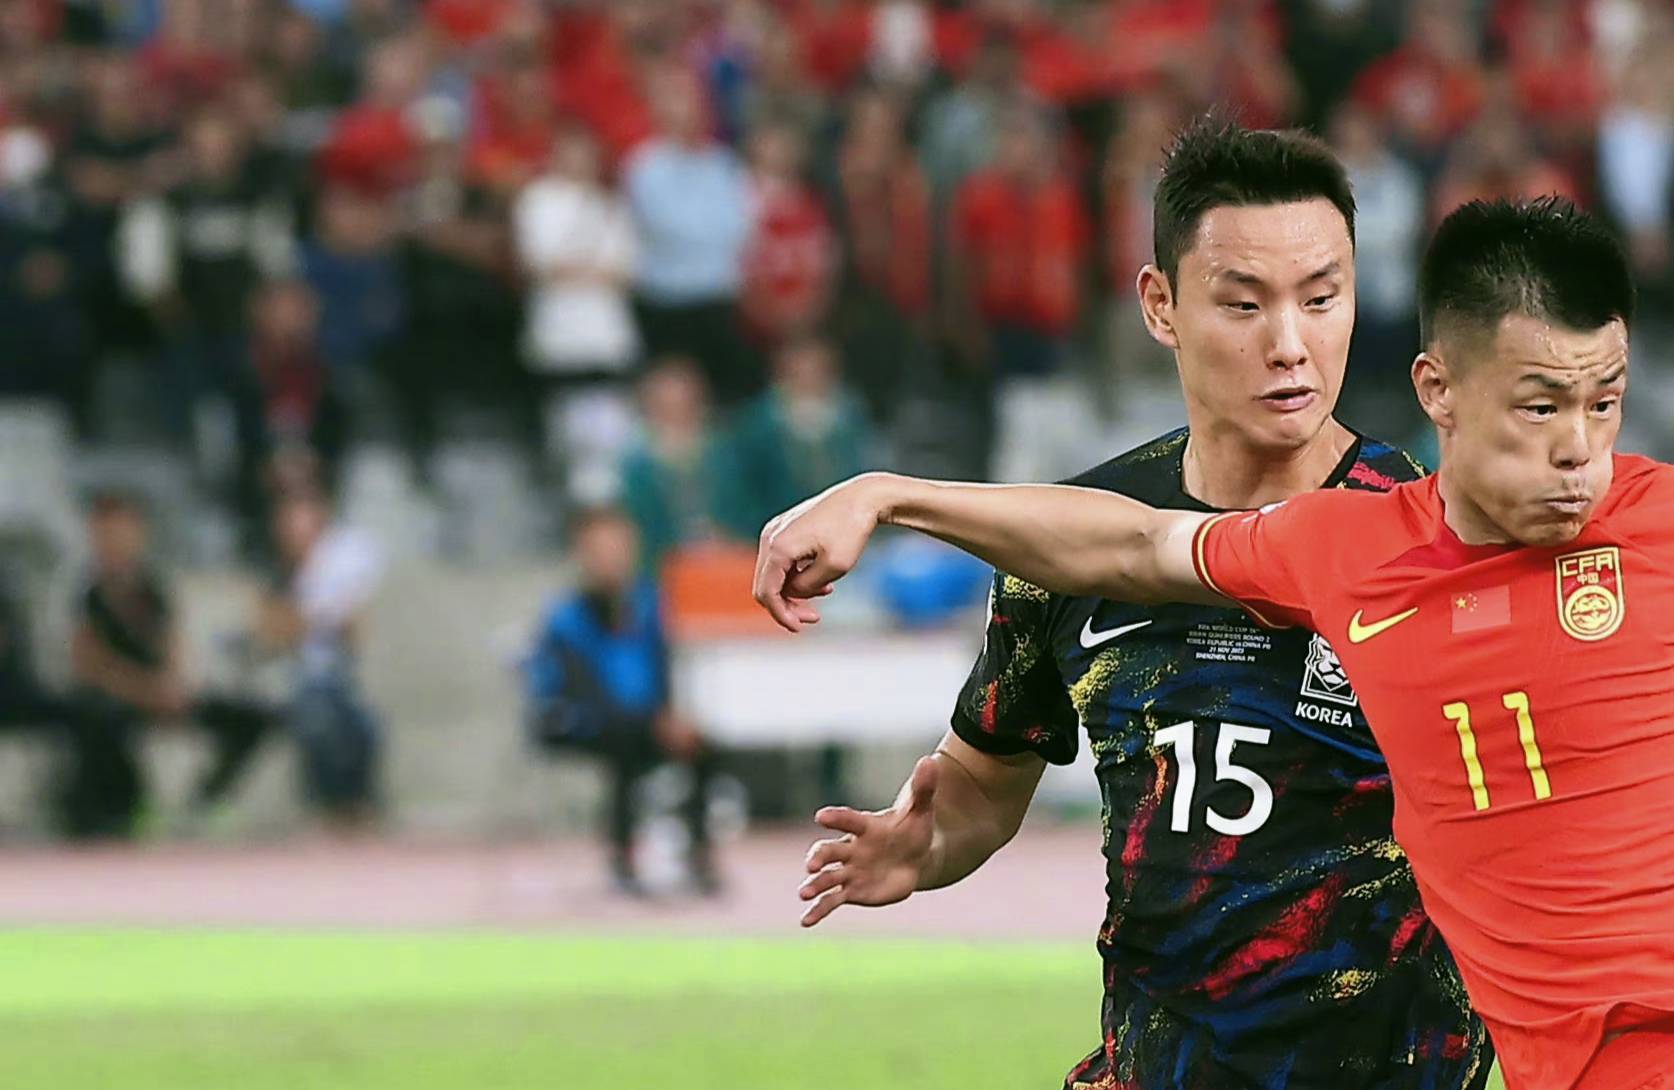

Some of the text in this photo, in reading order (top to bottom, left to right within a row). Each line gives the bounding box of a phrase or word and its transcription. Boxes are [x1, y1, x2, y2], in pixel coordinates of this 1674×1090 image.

[1562, 552, 1614, 577] CFA
[1576, 571, 1600, 585] 中国
[1242, 633, 1265, 642] ROUND
[1294, 700, 1353, 728] KOREA
[1442, 690, 1553, 812] 11
[1152, 720, 1274, 836] 15
